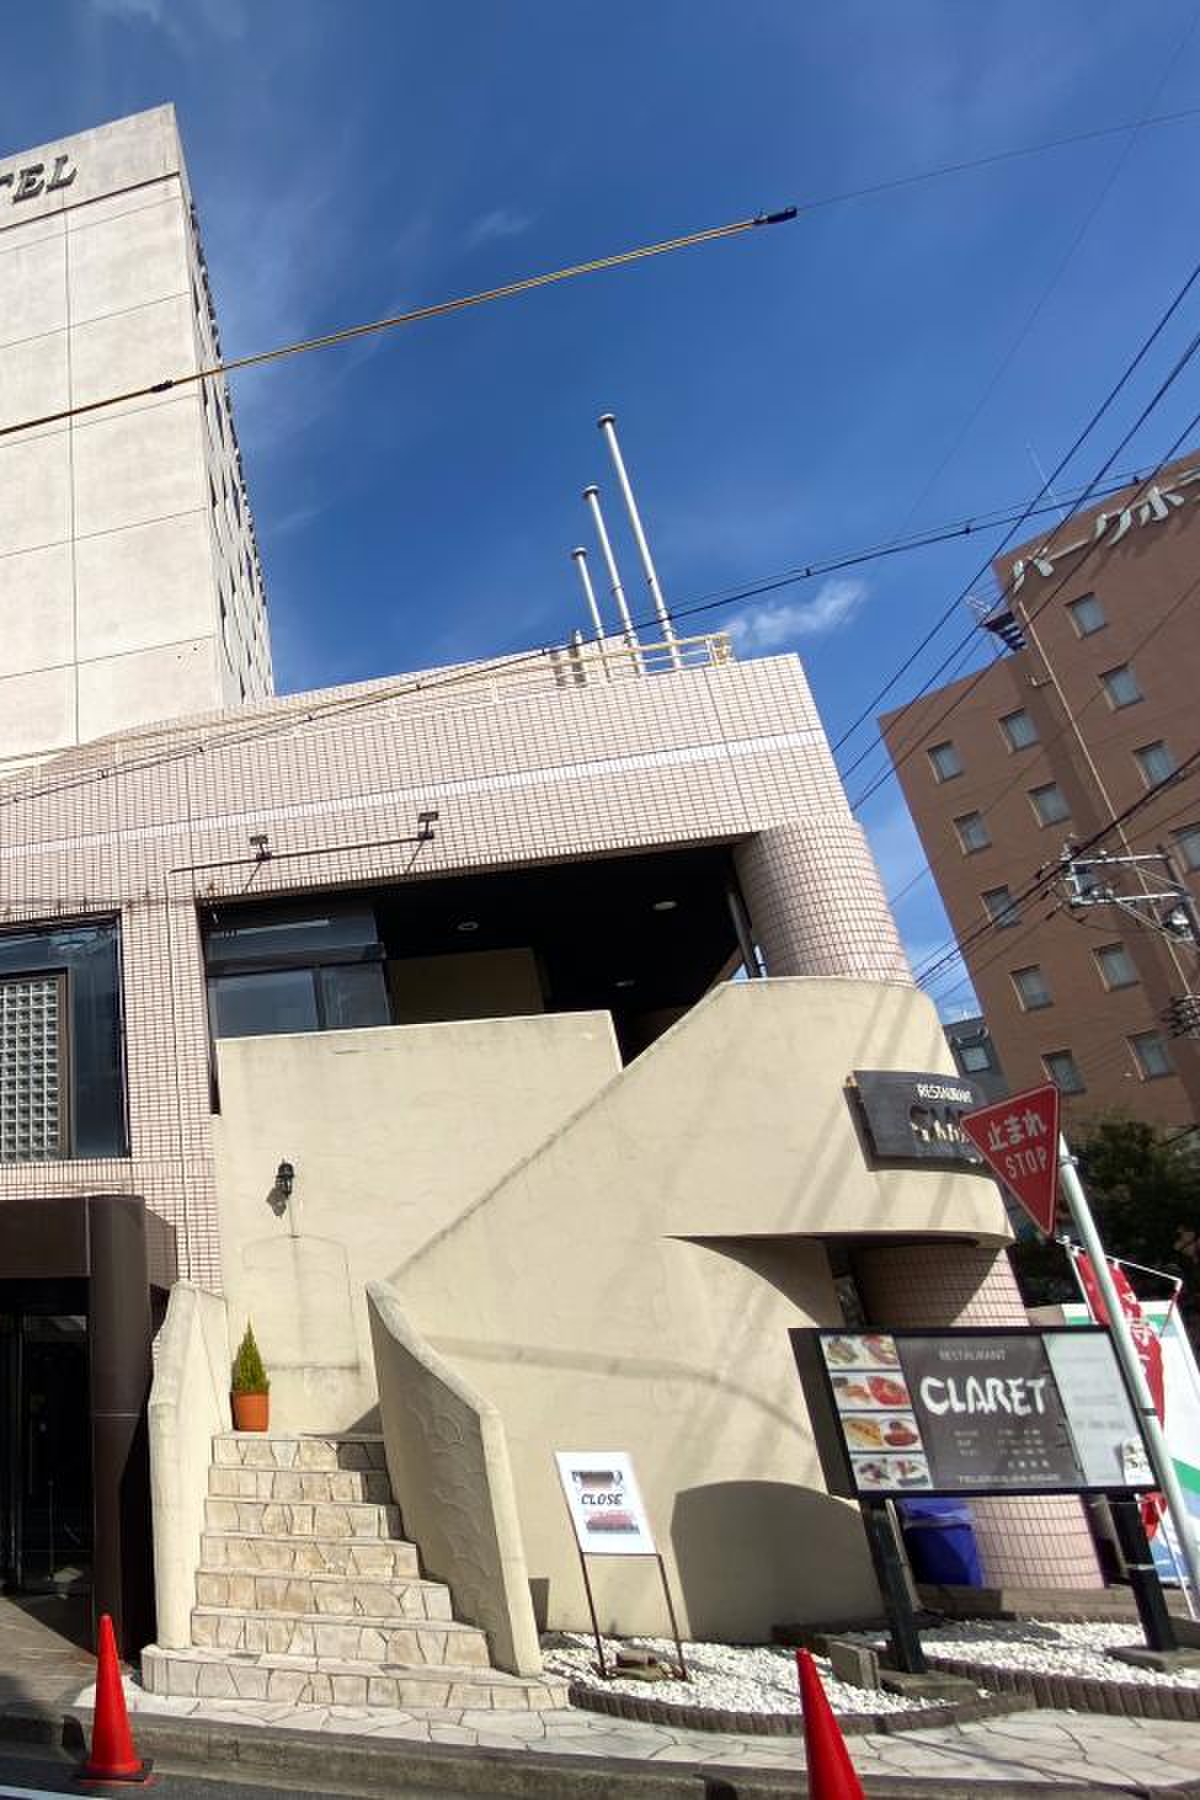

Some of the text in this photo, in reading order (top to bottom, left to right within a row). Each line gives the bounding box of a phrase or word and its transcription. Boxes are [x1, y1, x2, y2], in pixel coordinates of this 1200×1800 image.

[987, 1108, 1047, 1151] 止まれ
[1005, 1146, 1047, 1179] STOP
[920, 1375, 1047, 1416] CLARET
[580, 1493, 624, 1506] CLOSE
